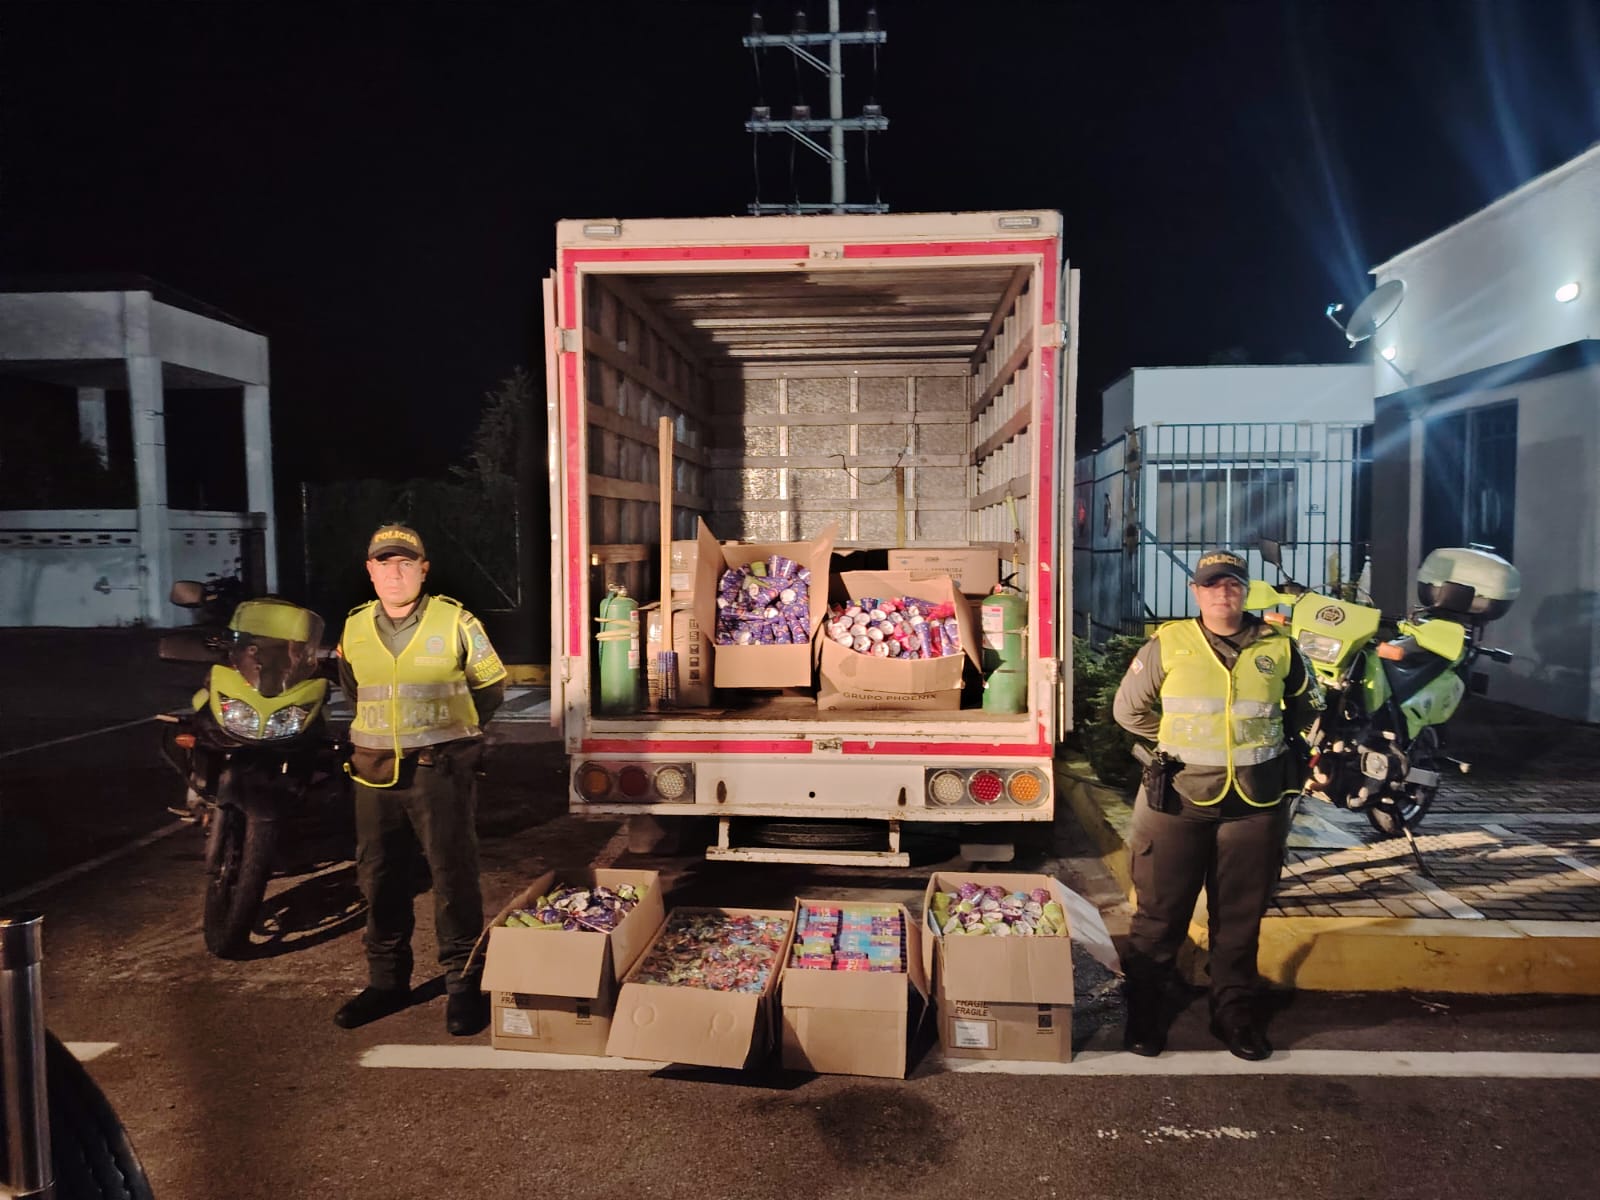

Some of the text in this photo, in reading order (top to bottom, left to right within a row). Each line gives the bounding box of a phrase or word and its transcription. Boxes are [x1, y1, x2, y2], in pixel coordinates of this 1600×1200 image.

[374, 530, 418, 546] POLICIA
[843, 692, 882, 701] GRUPO
[955, 1007, 988, 1016] FRAGILE
